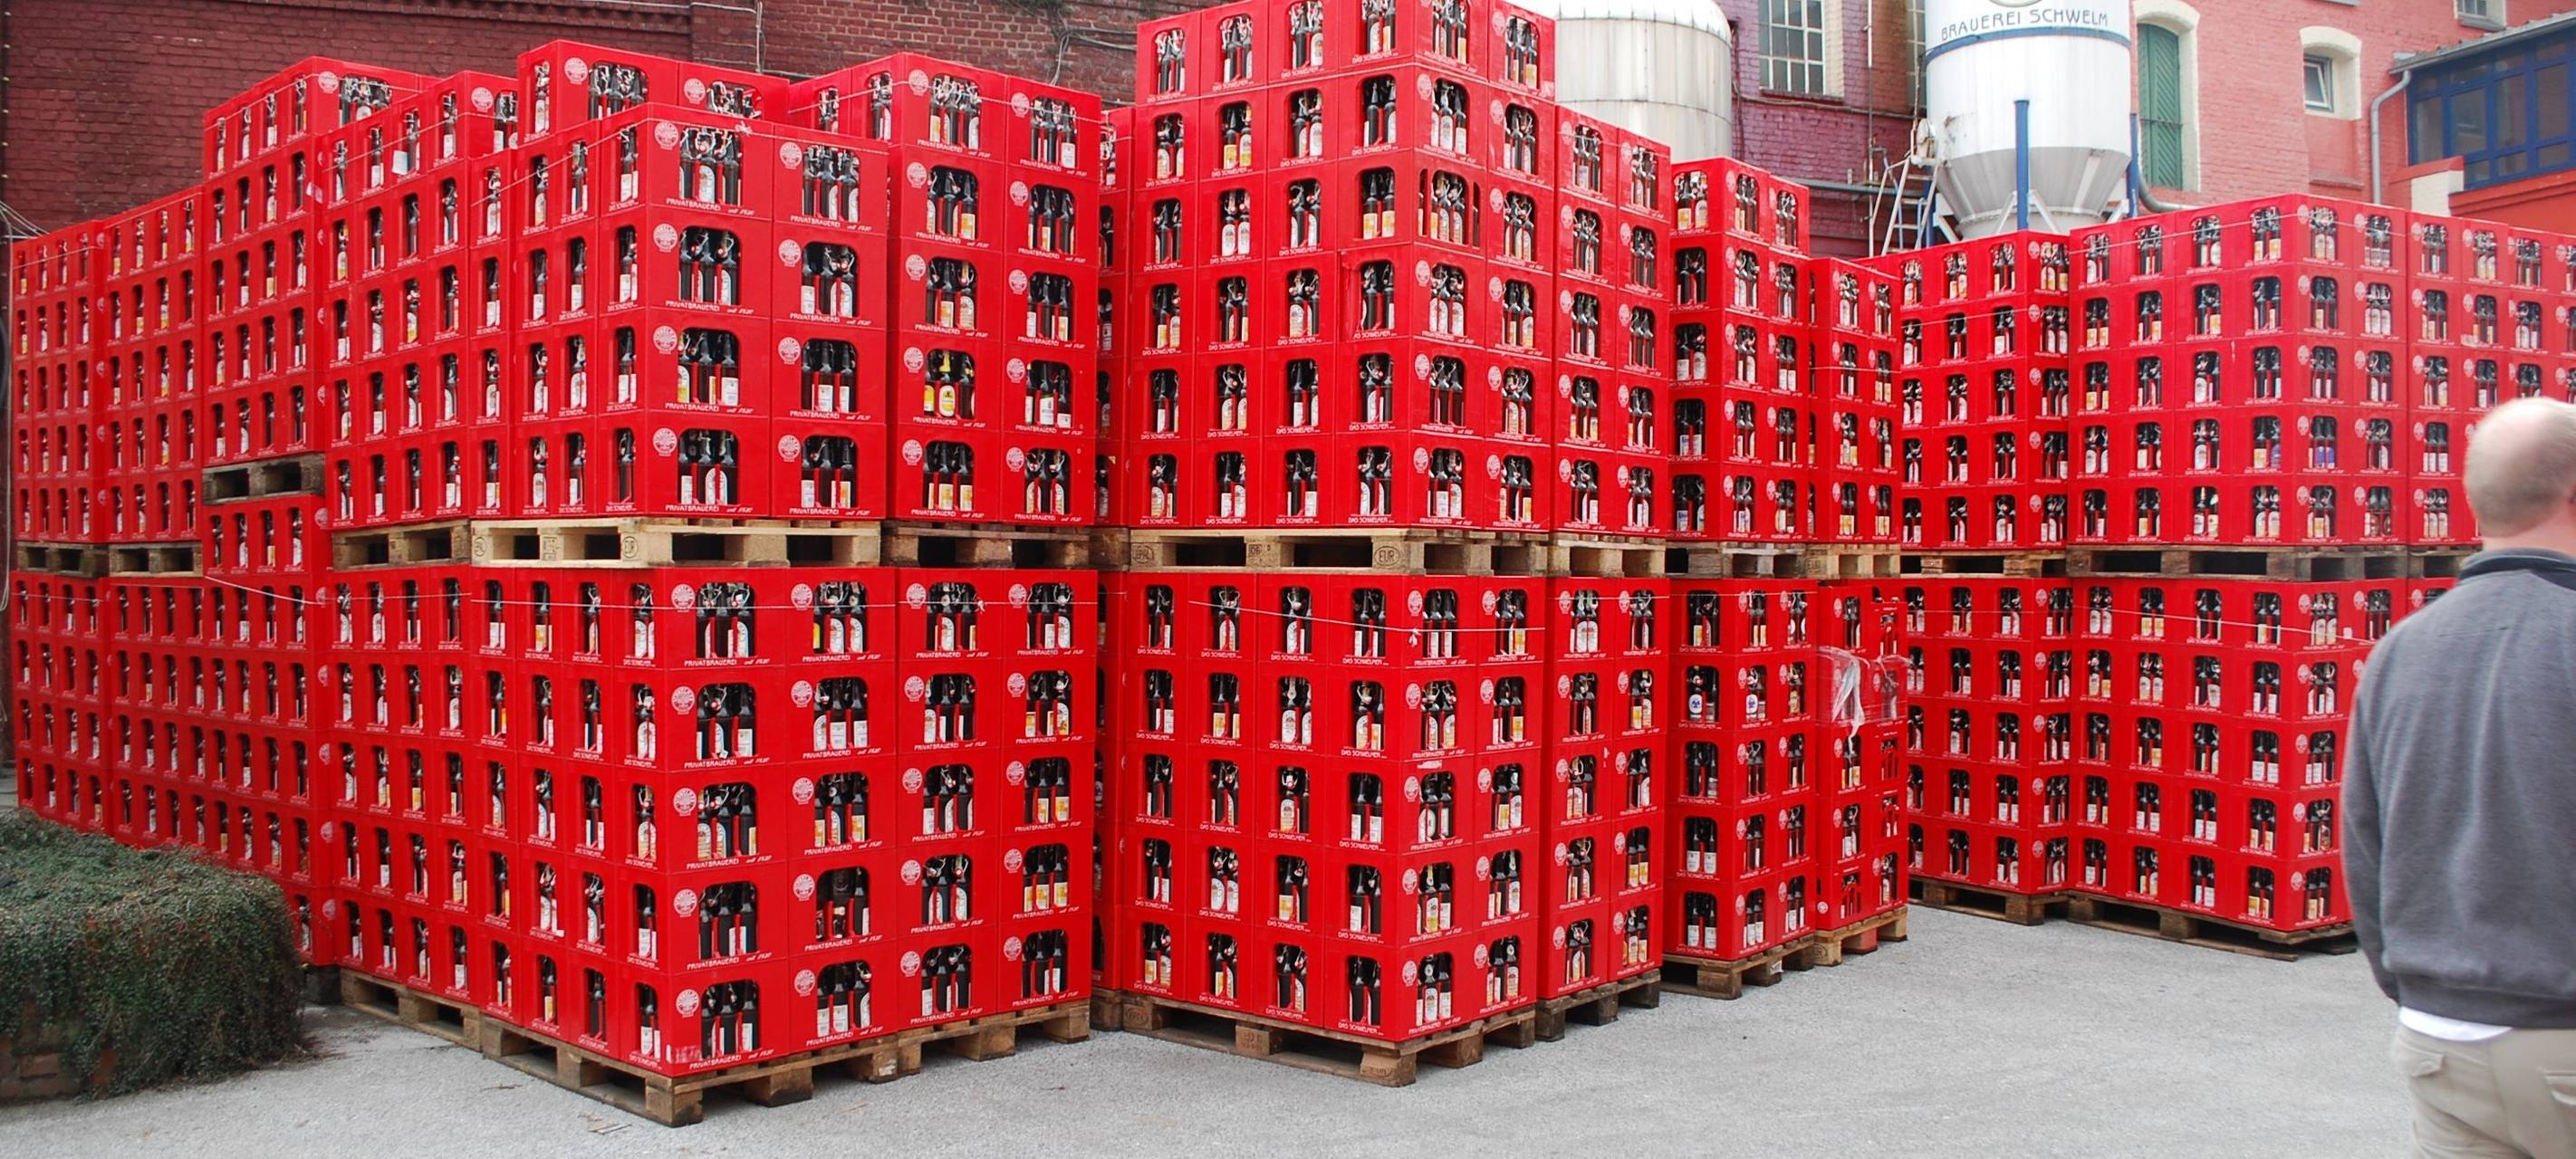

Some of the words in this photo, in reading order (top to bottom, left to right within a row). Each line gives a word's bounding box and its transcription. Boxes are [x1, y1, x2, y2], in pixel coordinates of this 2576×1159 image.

[1942, 12, 2020, 41] BRAUEREI
[2030, 8, 2108, 26] SCHWELM
[667, 198, 721, 211] PRIVATBRAUEREI
[791, 216, 841, 227] PRIVATBRAUEREI
[666, 301, 720, 311] PRIVATBRAUEREI
[790, 313, 840, 322] PRIVATBRAUEREI
[666, 403, 719, 411] PRIVATBRAUEREI
[790, 411, 840, 419] PRIVATBRAUEREI
[1379, 550, 1395, 562] EUR
[803, 750, 851, 759] PRIVATBRAUEREI
[685, 760, 736, 769] PRIVATBRAUEREI
[804, 844, 852, 856] PRIVATBRAUEREI
[687, 858, 739, 869] PRIVATBRAUEREI
[805, 940, 852, 951] PRIVATBRAUEREI
[687, 958, 739, 970] PRIVATBRAUEREI
[807, 1032, 853, 1046] PRIVATBRAUEREI
[689, 1055, 741, 1069] PRIVATBRAUEREI
